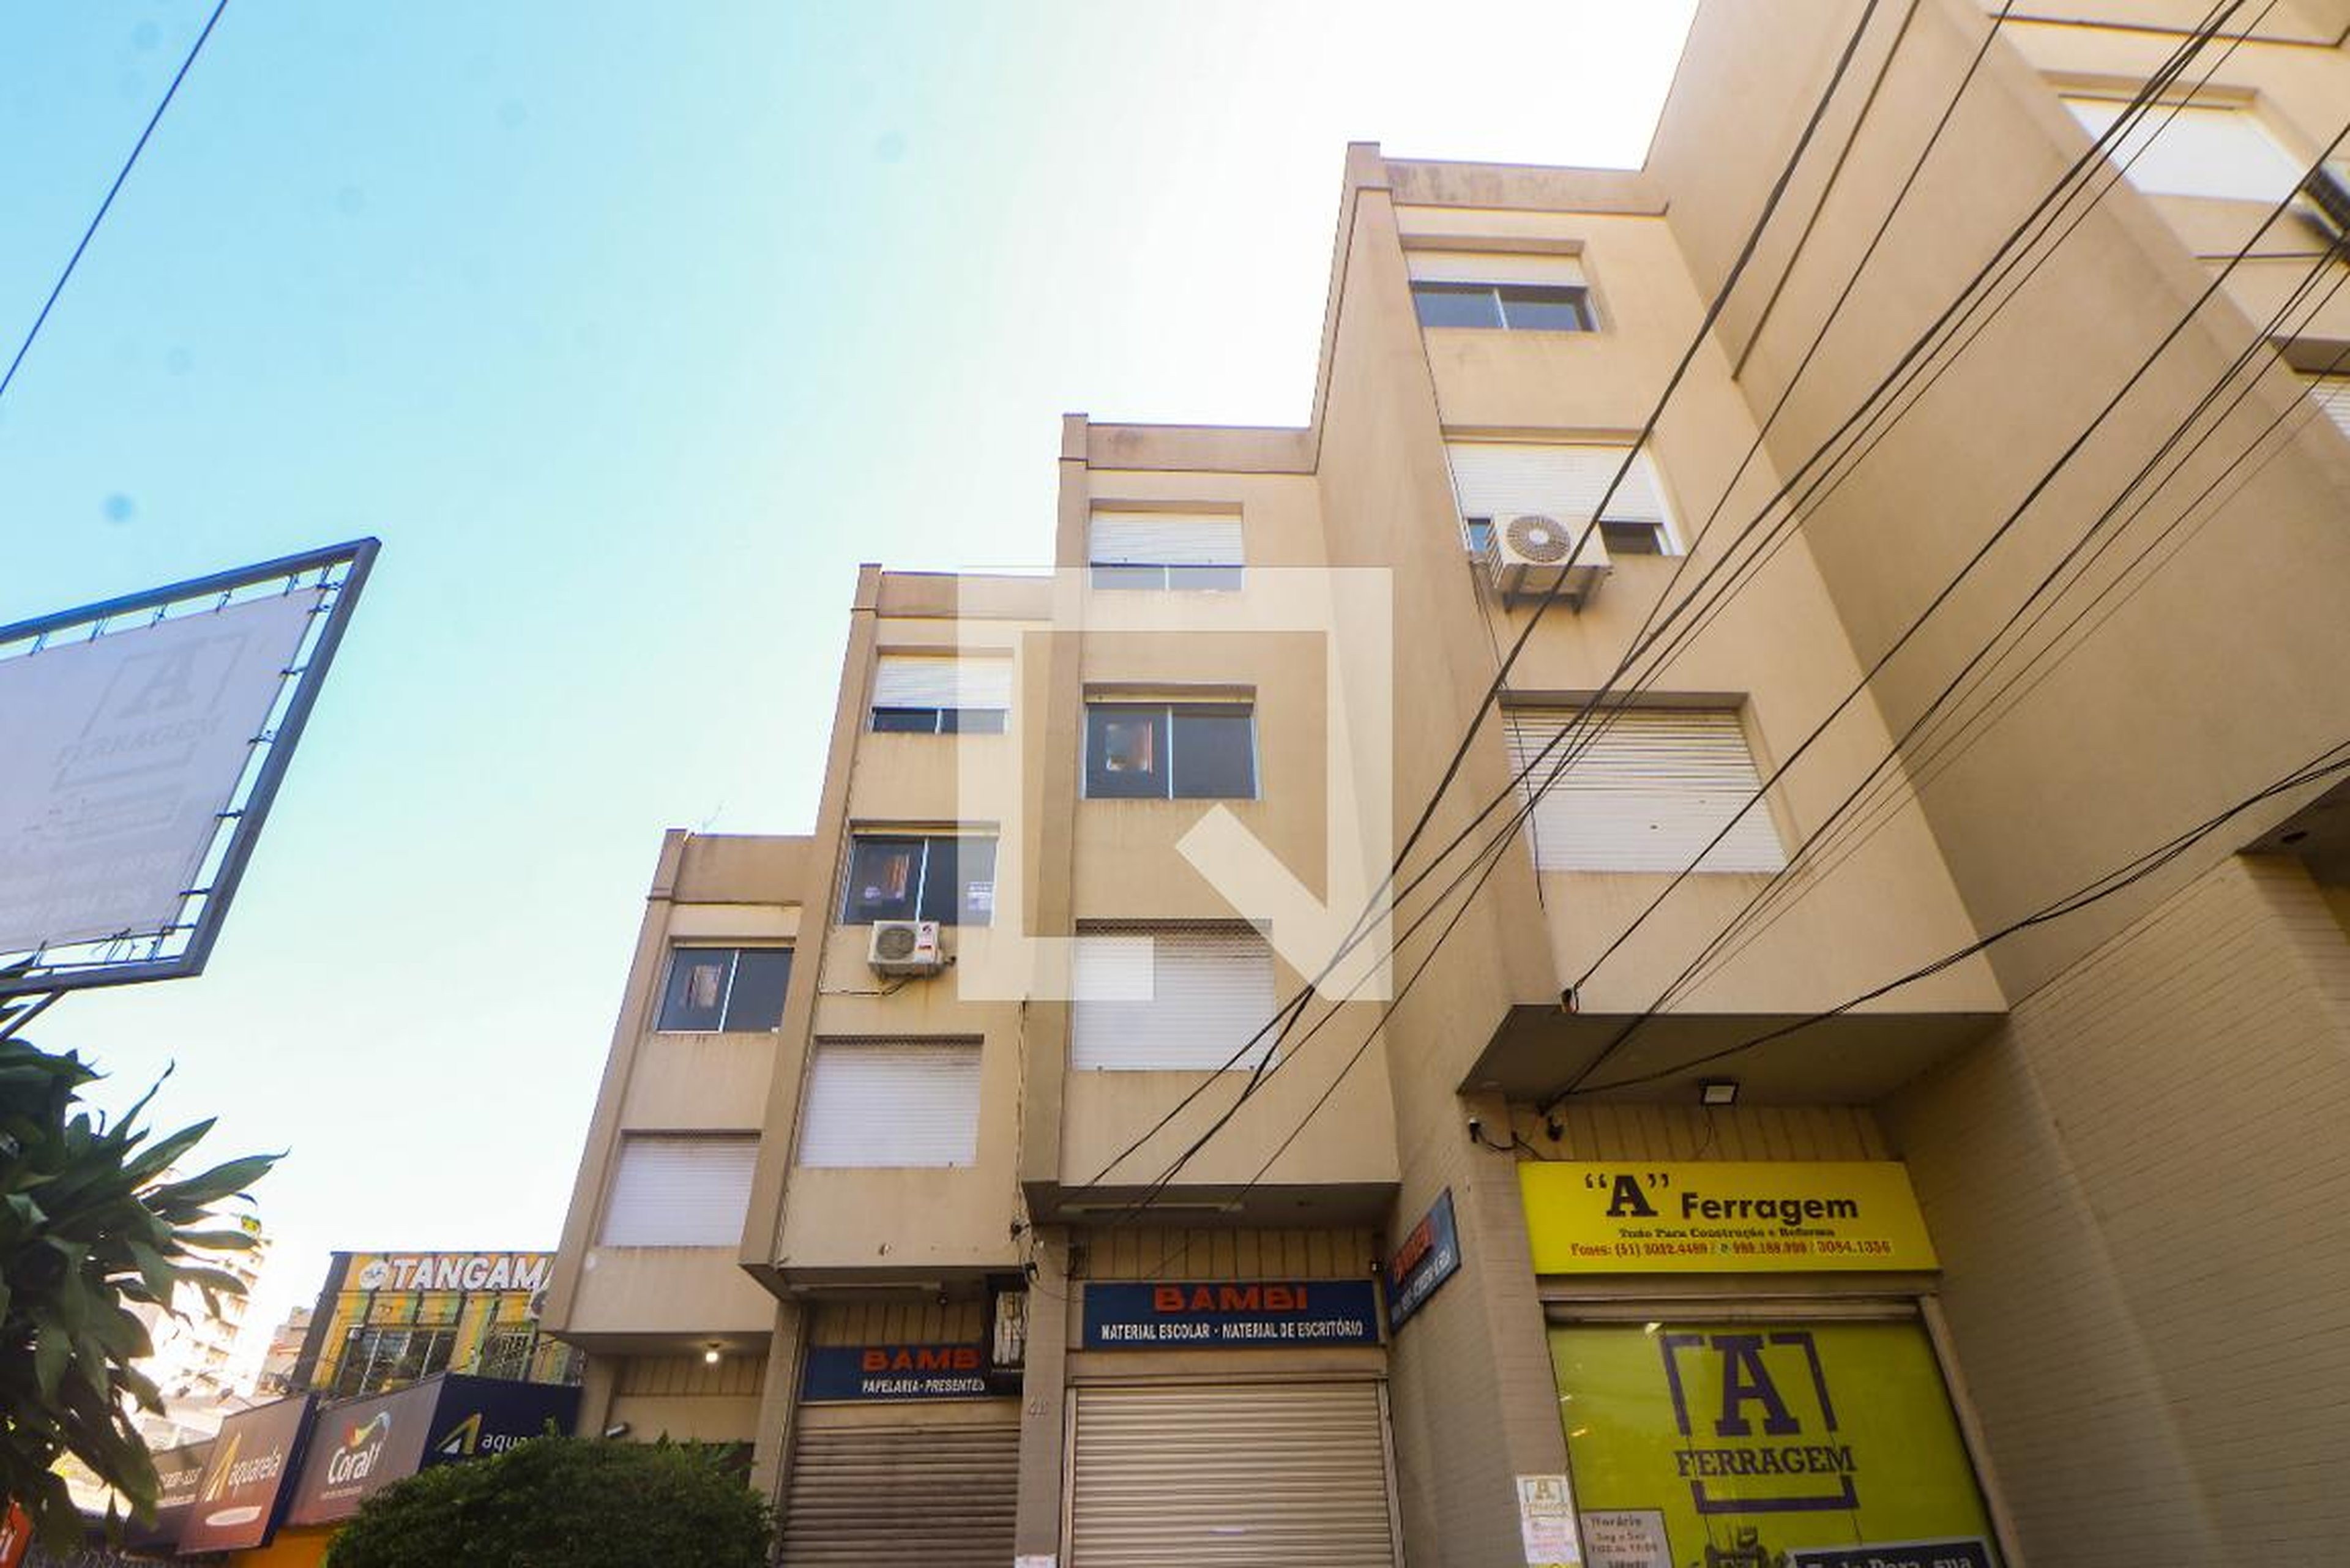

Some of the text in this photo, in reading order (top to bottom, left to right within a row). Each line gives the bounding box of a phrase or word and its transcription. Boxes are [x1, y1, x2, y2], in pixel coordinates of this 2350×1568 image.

[1681, 1193, 1859, 1224] Ferragem
[1655, 1228, 1687, 1238] Para
[1571, 1242, 1612, 1255] Fones:
[1154, 1285, 1308, 1311] BAMBI
[1102, 1318, 1363, 1340] MATERIAL ESCOLAR MATERIAL DE ESCRITÓRIO
[863, 1348, 980, 1372] BAMB
[862, 1377, 985, 1393] PAPELARIA PRESENTES
[1710, 1334, 1800, 1437] A
[1674, 1446, 1858, 1477] FERRAGEM
